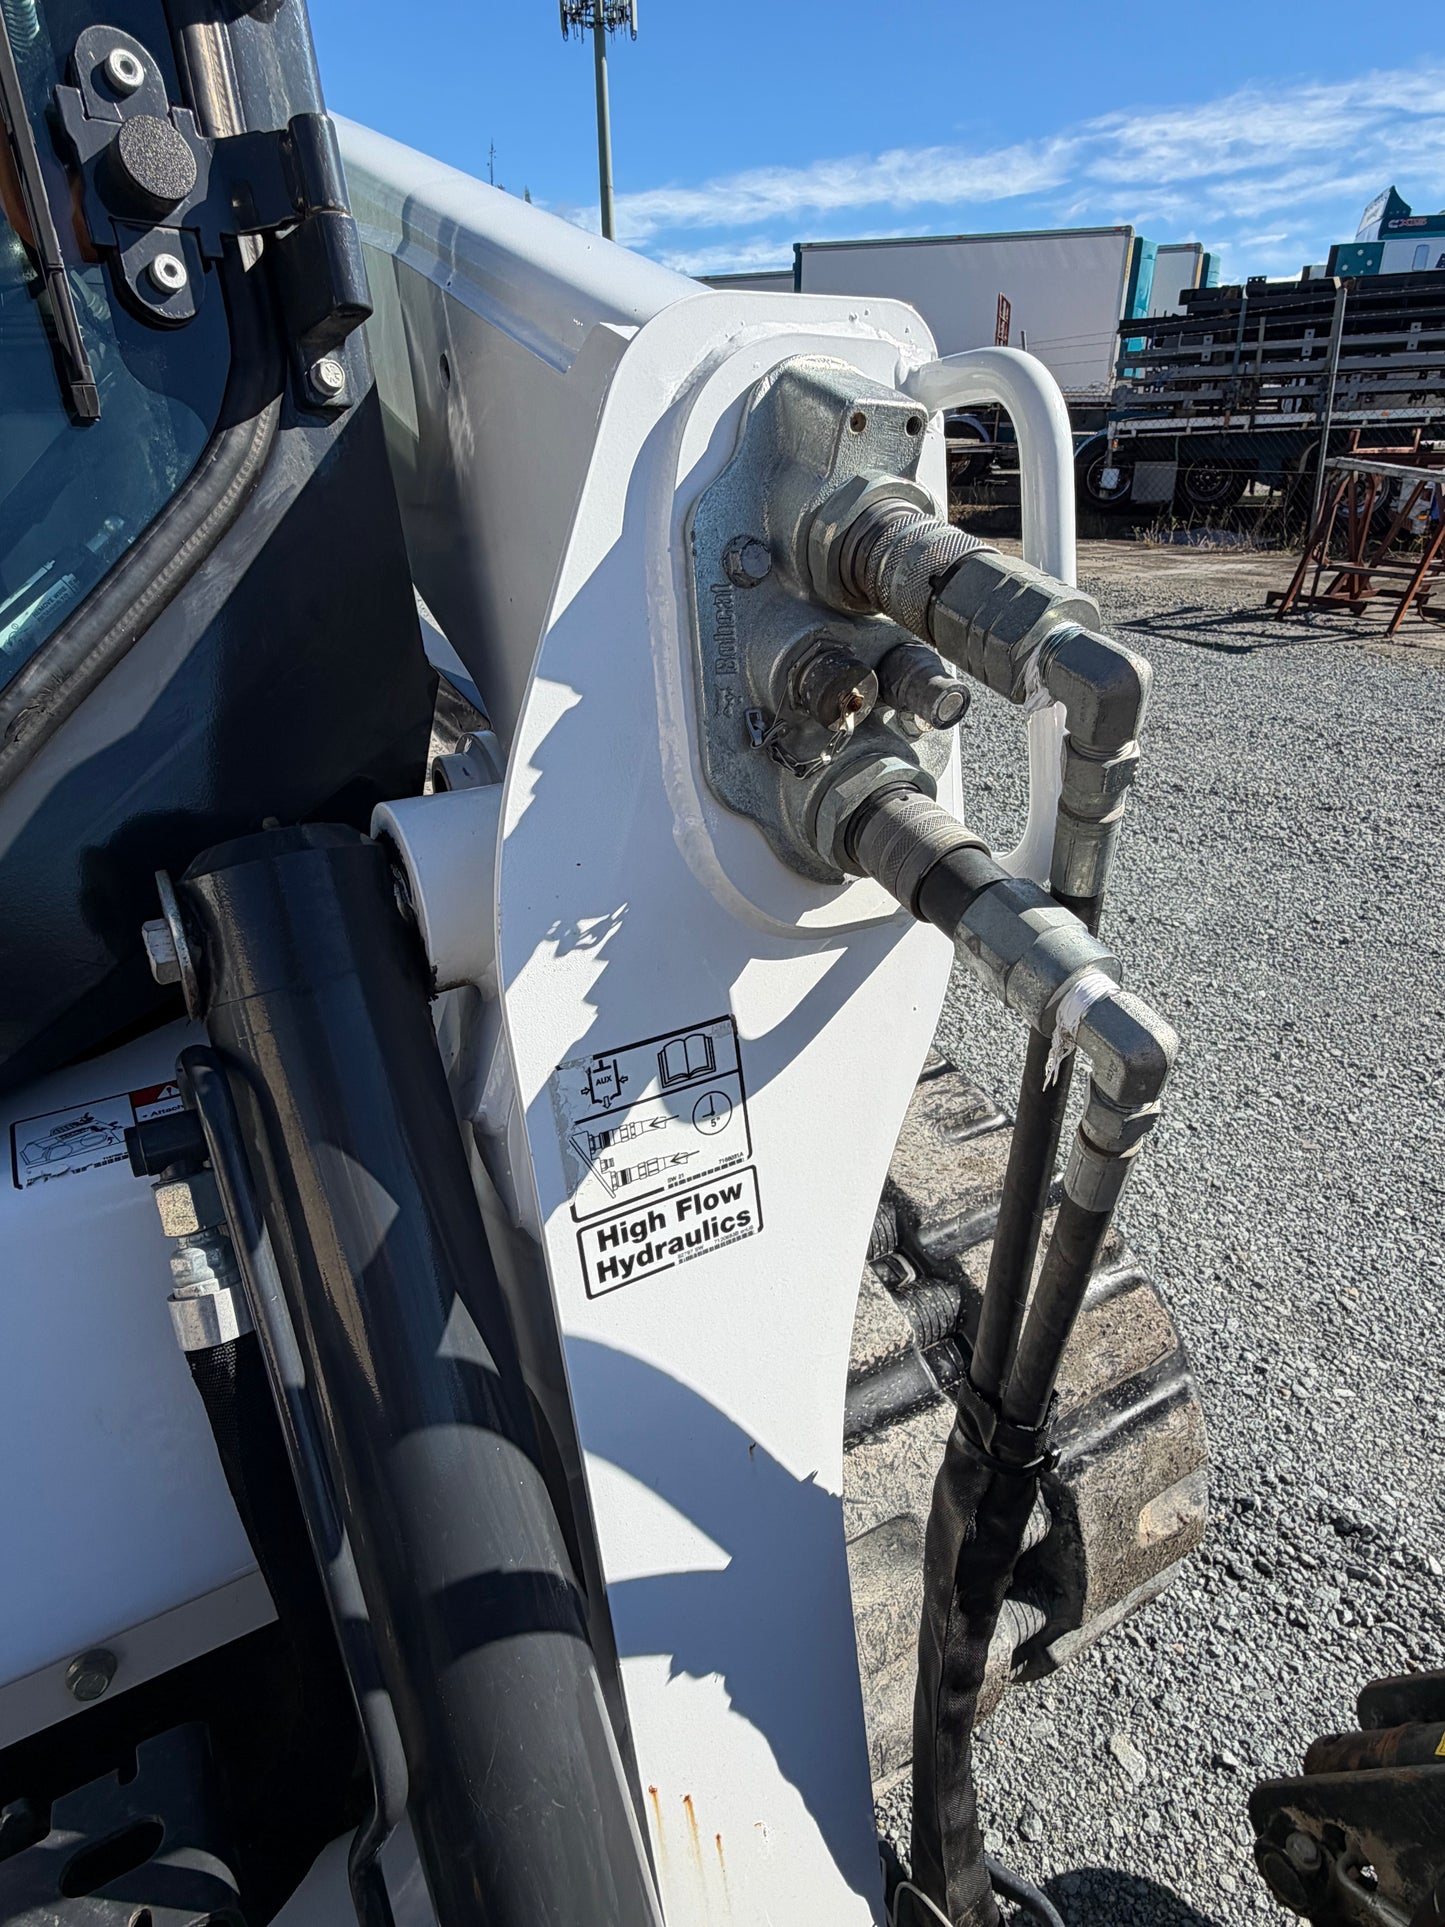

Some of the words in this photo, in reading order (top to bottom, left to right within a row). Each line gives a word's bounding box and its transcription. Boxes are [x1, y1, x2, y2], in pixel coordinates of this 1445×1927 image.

[710, 583, 738, 675] Bobcat
[595, 1075, 612, 1087] AUX
[597, 1209, 751, 1283] Hydraulics
[598, 1210, 665, 1252] High
[676, 1182, 742, 1222] Flow
